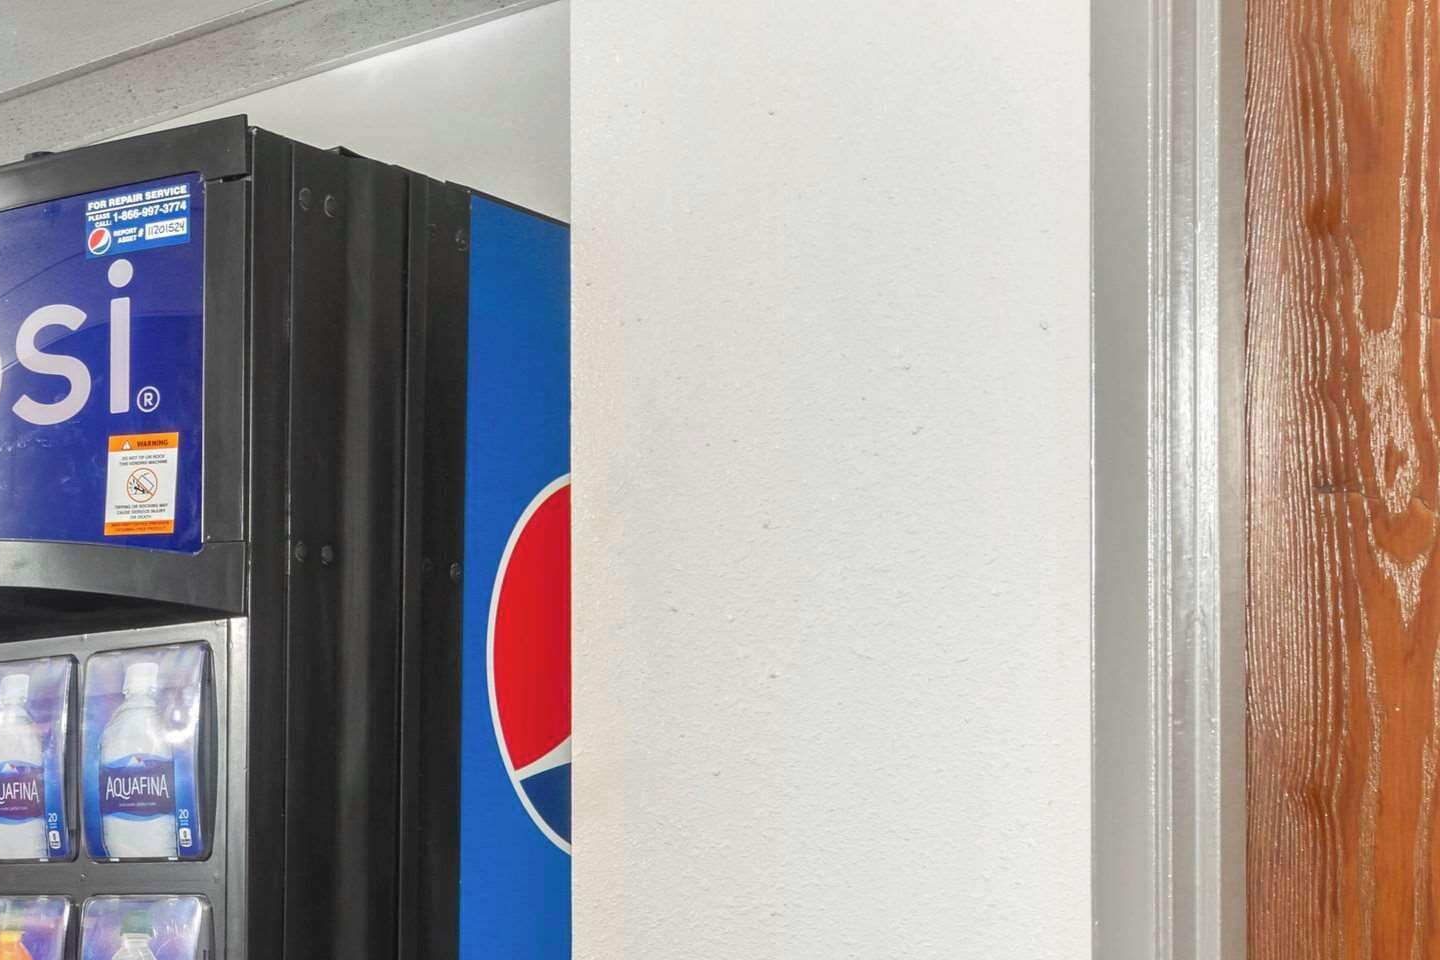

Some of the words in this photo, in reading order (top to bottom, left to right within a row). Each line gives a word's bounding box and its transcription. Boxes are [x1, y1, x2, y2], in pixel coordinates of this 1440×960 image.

[87, 201, 107, 211] FOR
[109, 193, 143, 207] REPAIR
[145, 185, 187, 200] SERVICE
[113, 200, 187, 222] 1-866-997-3774
[87, 212, 111, 222] PLEASE
[136, 439, 169, 448] WARNING
[106, 774, 170, 801] AQUAFINA
[47, 813, 58, 822] 20
[178, 809, 189, 819] 20
